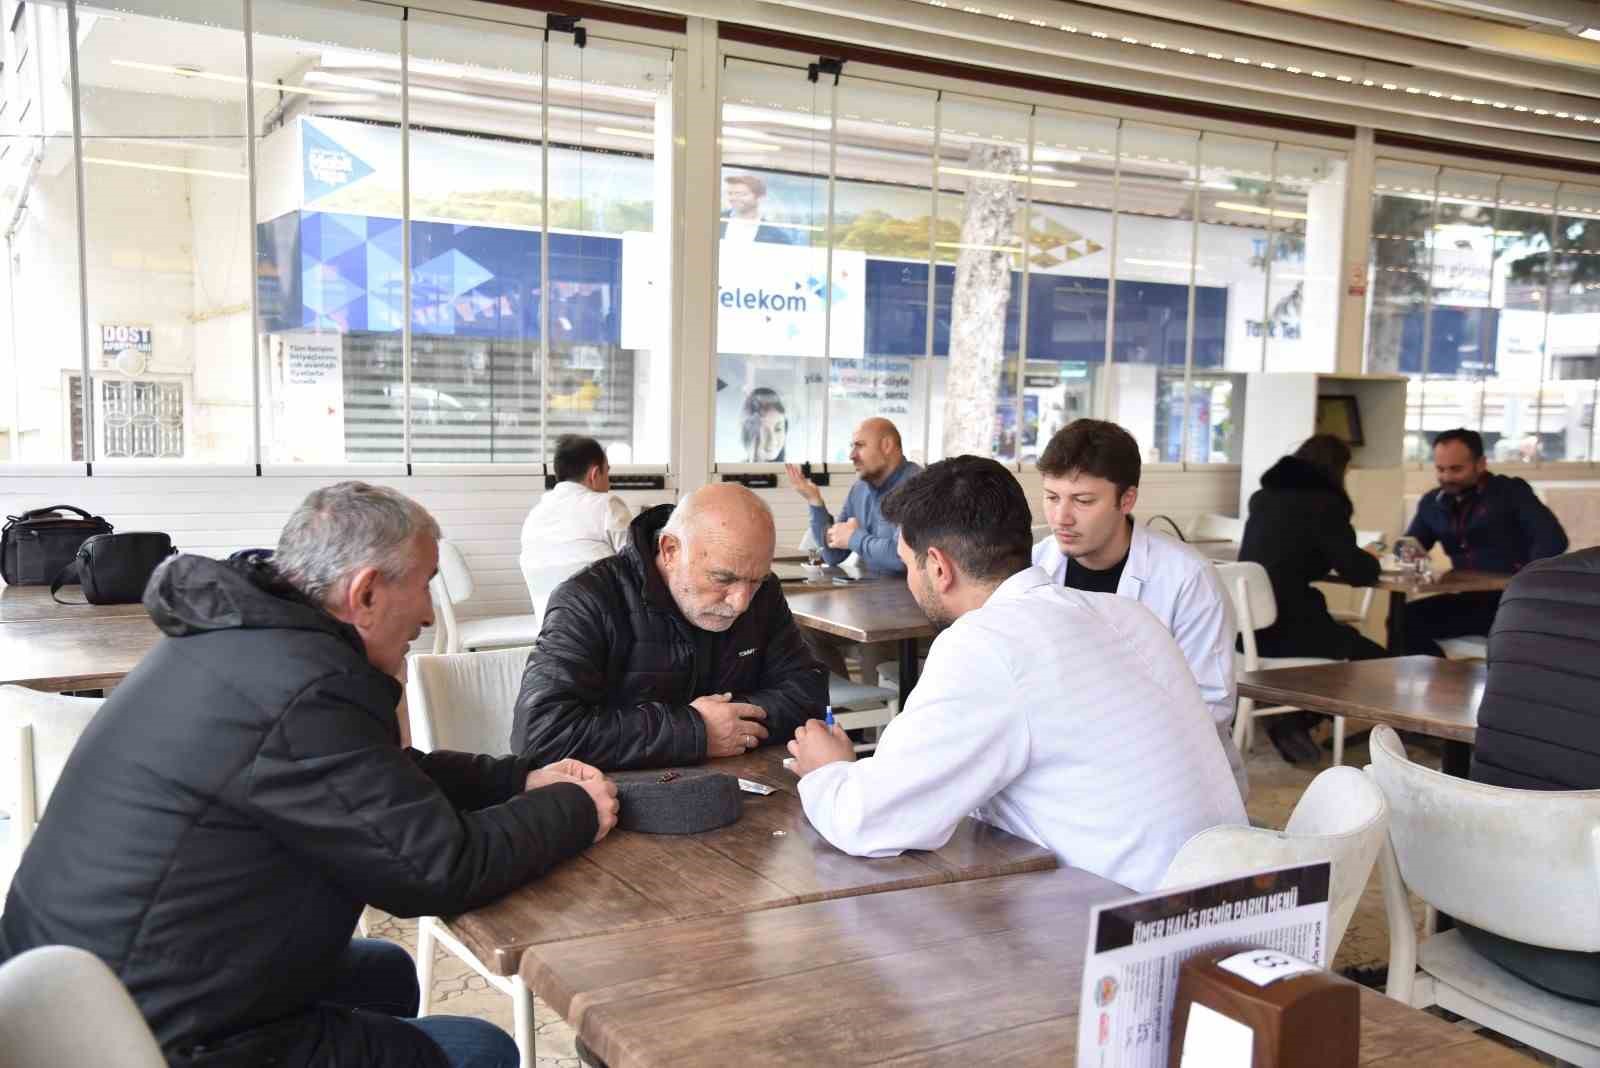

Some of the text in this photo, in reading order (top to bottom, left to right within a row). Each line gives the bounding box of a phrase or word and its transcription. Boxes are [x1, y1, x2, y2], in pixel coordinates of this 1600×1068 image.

[718, 285, 807, 312] elekom
[103, 326, 152, 343] DOST
[1132, 886, 1299, 945] ÖMER HALİS DEMİR PARKI MENÜ
